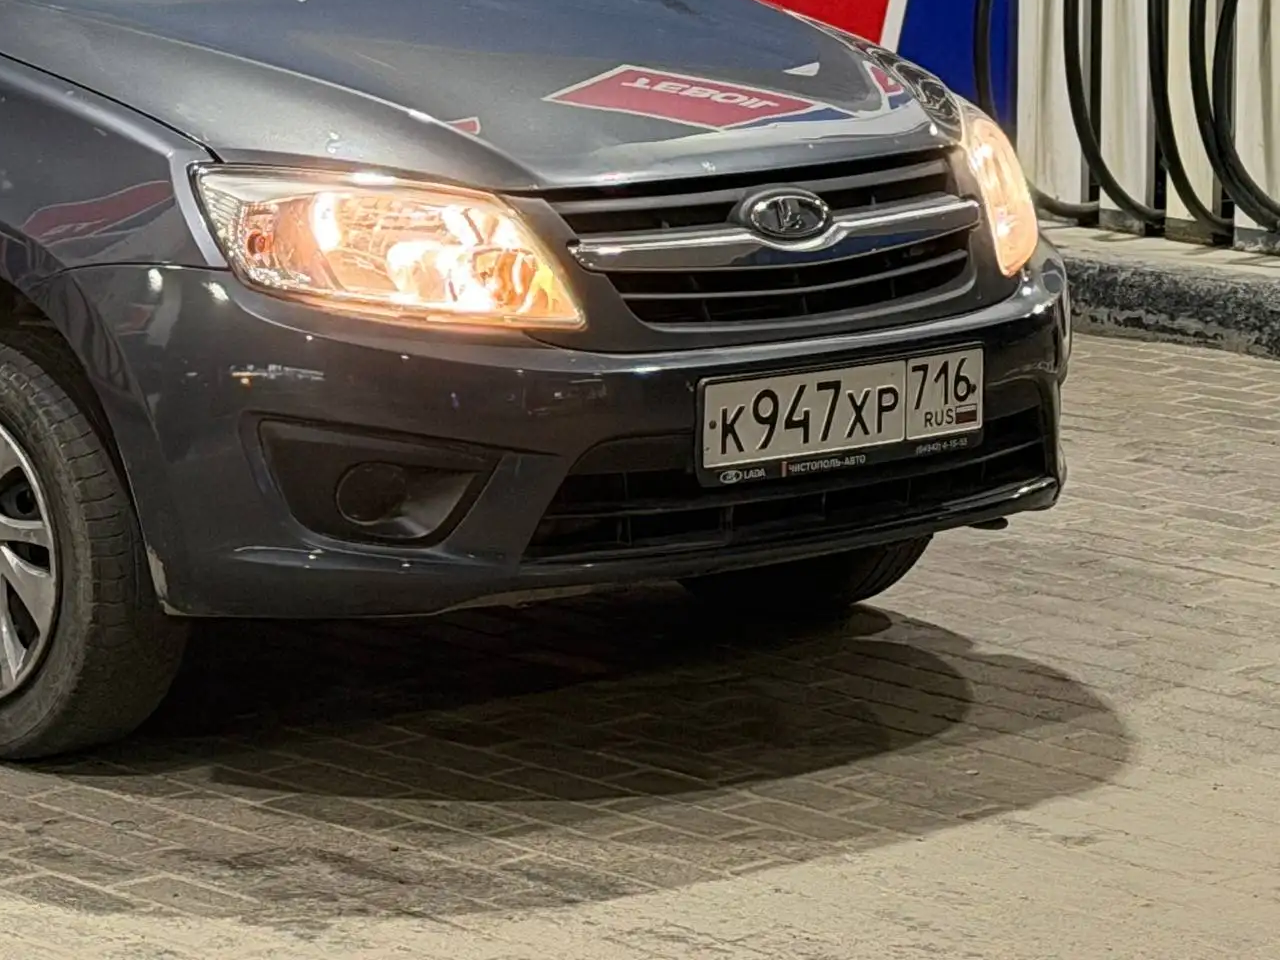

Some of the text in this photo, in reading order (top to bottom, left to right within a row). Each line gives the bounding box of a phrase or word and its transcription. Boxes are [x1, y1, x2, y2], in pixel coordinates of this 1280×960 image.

[911, 357, 972, 410] 716
[923, 407, 955, 428] RUS
[788, 454, 867, 473] ЧИСТОПОЛЬ-АВТО
[743, 468, 767, 480] LADA
